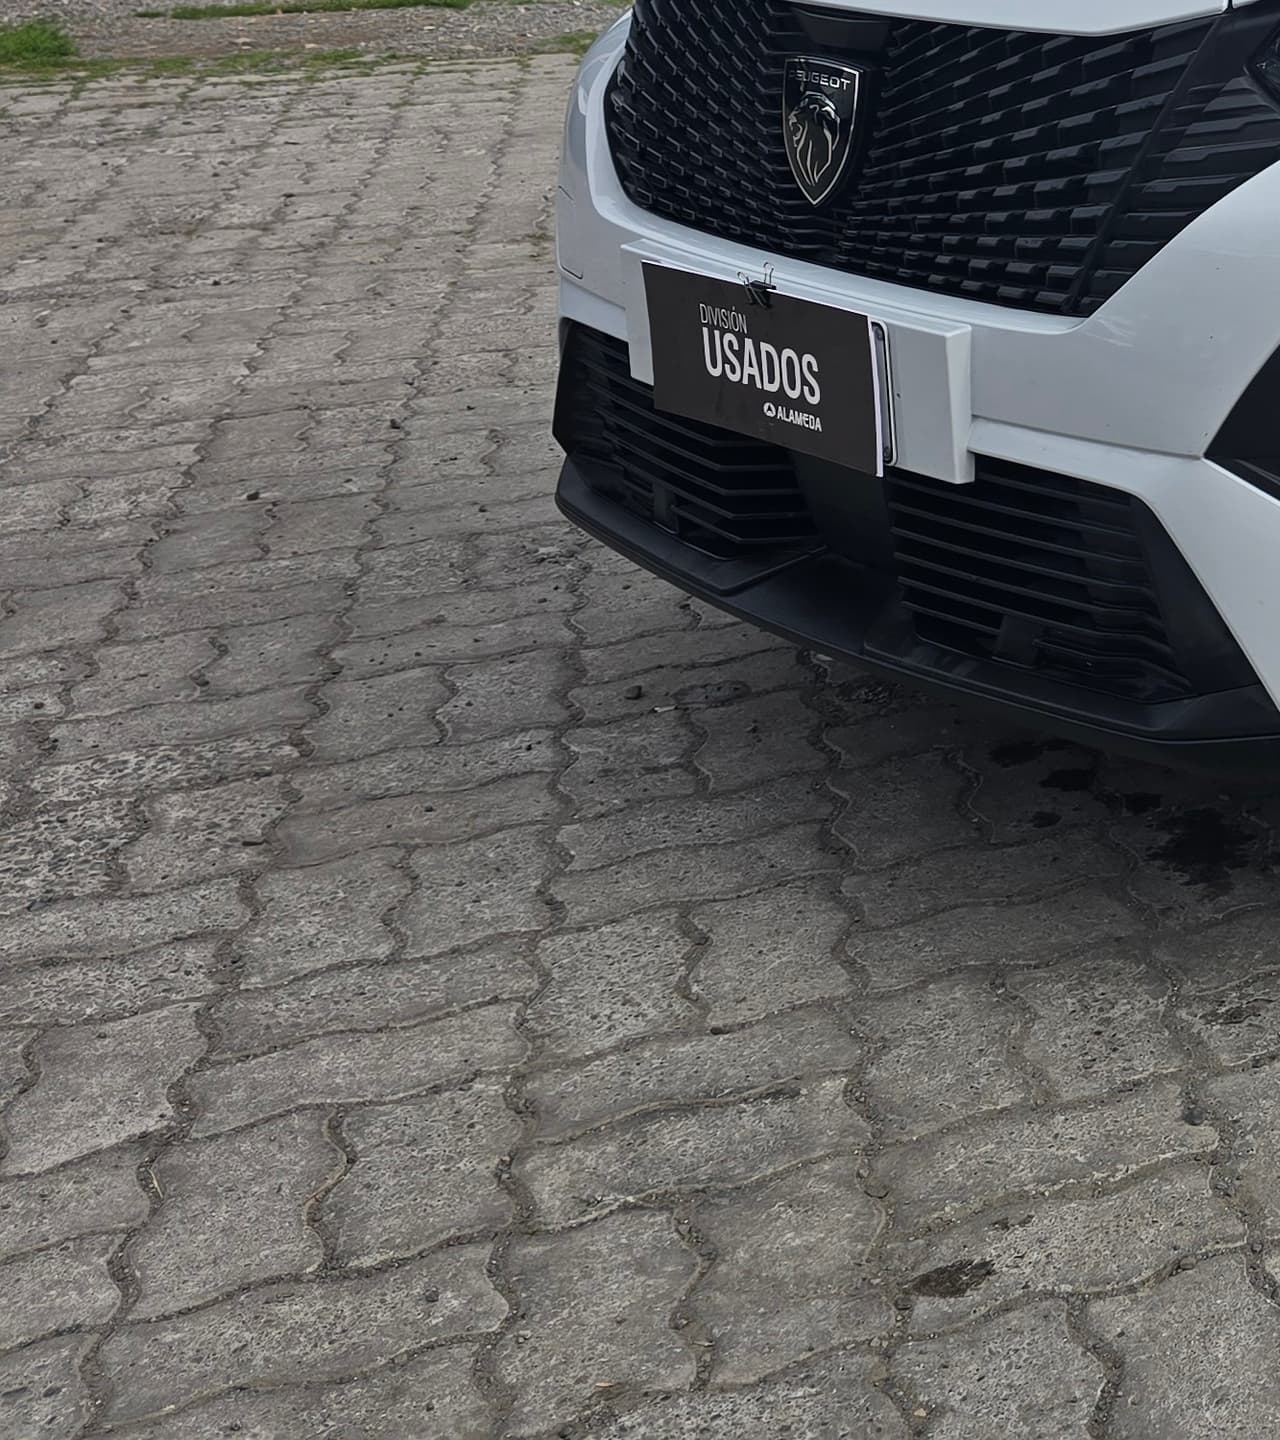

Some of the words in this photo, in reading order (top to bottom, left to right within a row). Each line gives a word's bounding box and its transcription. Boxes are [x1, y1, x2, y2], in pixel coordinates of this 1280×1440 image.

[700, 303, 748, 334] DIVISIÓN
[702, 326, 821, 405] USADOS
[776, 406, 823, 432] ALAMEDA
